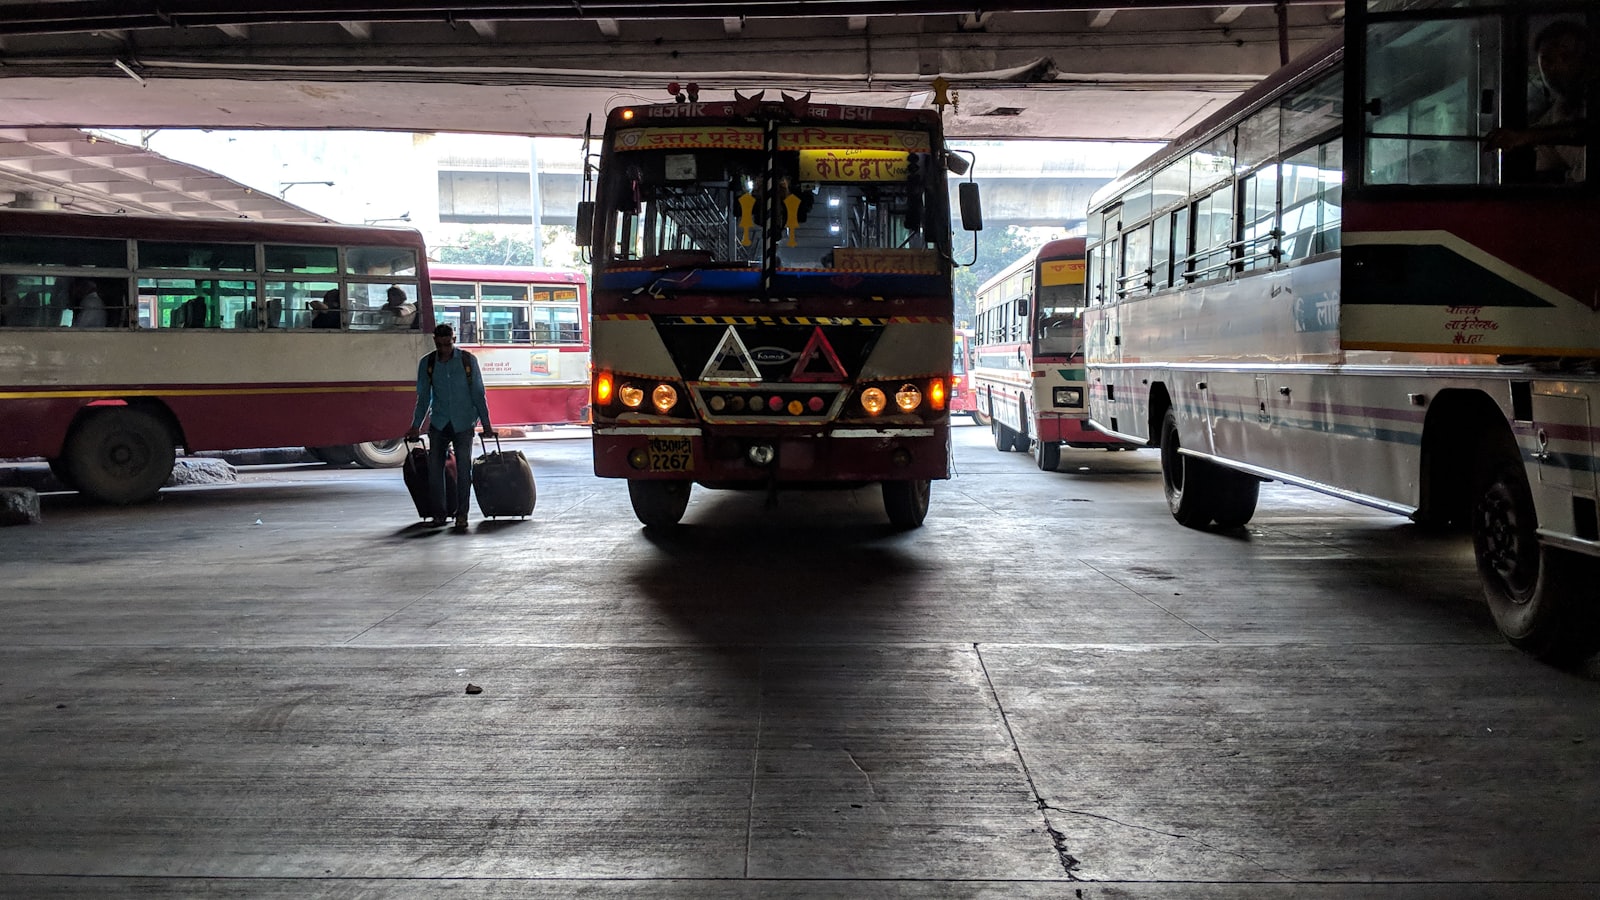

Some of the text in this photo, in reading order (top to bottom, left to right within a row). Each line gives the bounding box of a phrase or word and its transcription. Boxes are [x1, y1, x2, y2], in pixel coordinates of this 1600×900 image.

[646, 128, 892, 146] उत्तर प्रदेश परिवहन
[816, 152, 903, 180] कोटद्वार
[652, 454, 690, 470] 2267
